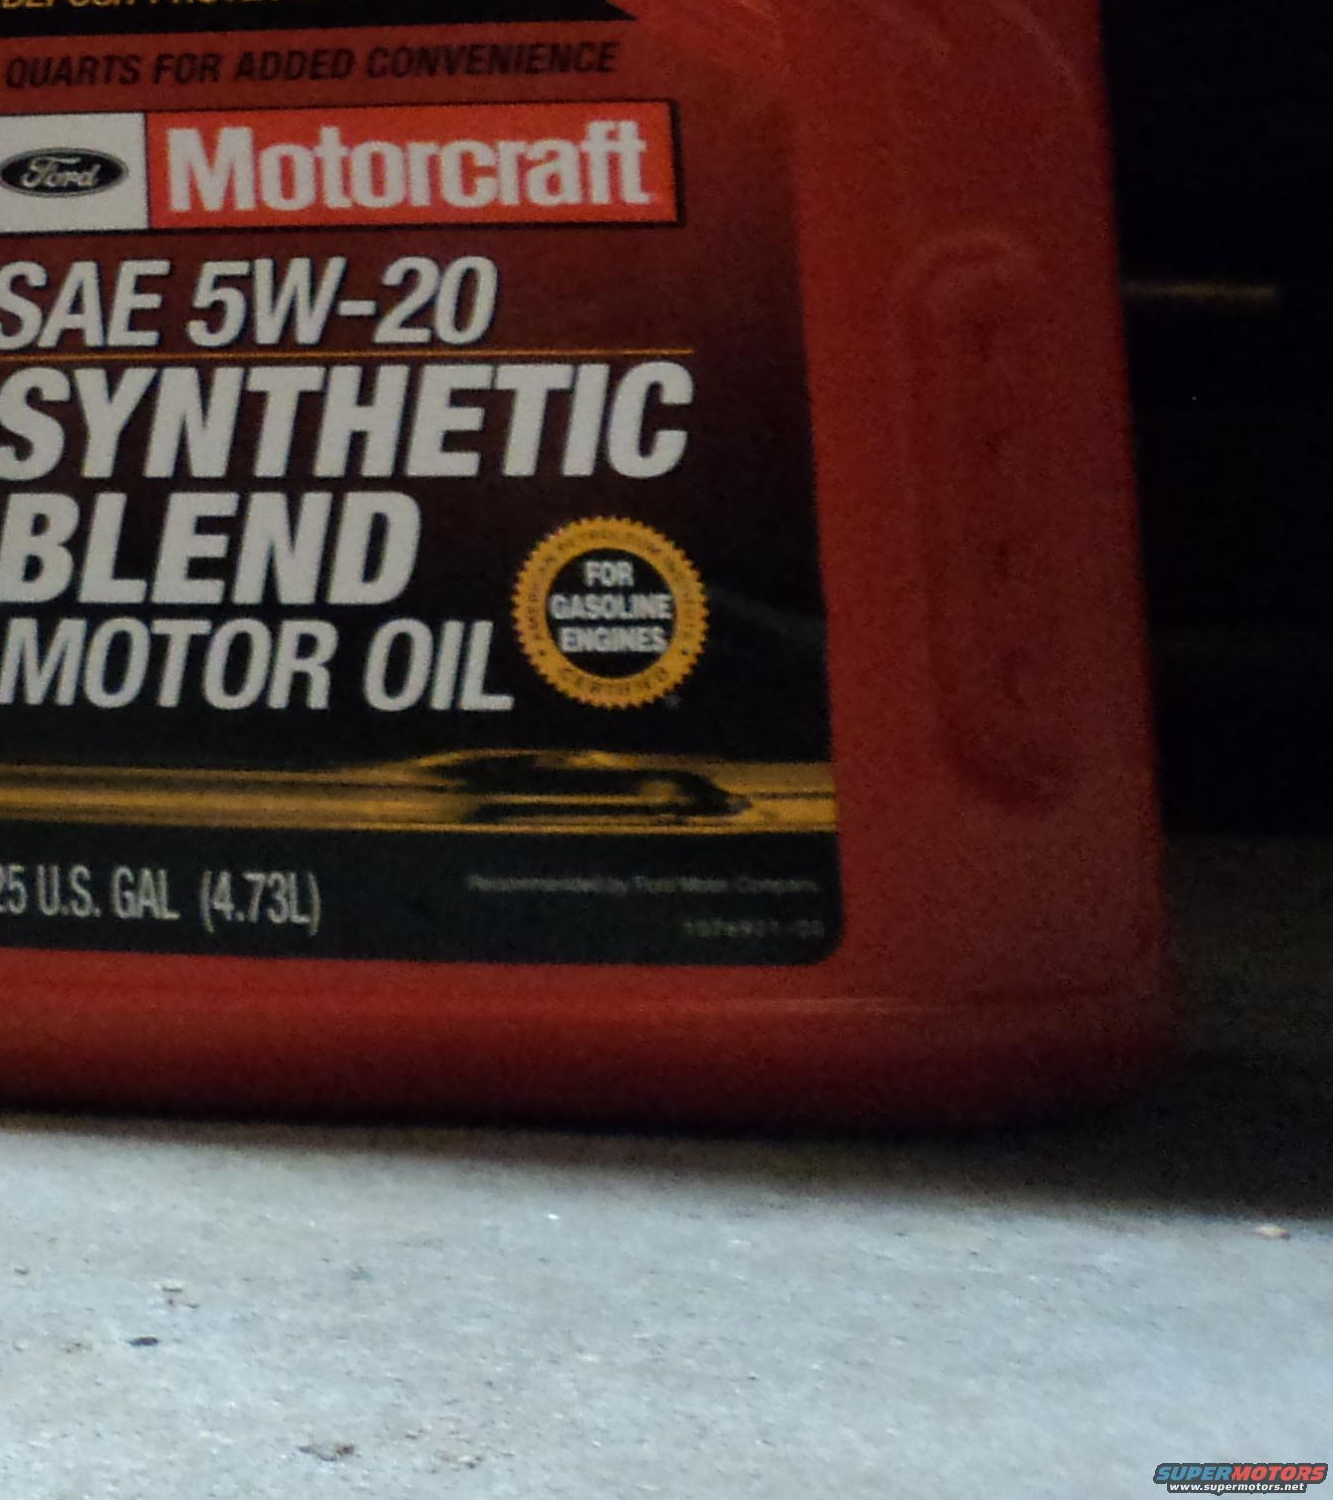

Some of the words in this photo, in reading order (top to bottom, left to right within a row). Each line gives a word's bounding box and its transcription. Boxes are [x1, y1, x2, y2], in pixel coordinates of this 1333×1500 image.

[6, 56, 143, 89] QUARTS
[153, 53, 221, 85] FOR
[234, 48, 355, 82] ADDED
[365, 42, 619, 78] CONVENIENCE
[21, 155, 102, 190] Ford
[167, 120, 651, 214] Motorcraft
[188, 255, 499, 348] 5W-20
[585, 561, 633, 587] FOR
[549, 593, 672, 620] GASOLINE
[363, 620, 514, 712] OIL
[560, 626, 669, 653] ENGINES
[36, 866, 100, 918] U.S.
[112, 866, 178, 920] GAL
[200, 872, 321, 935] (4.73L)
